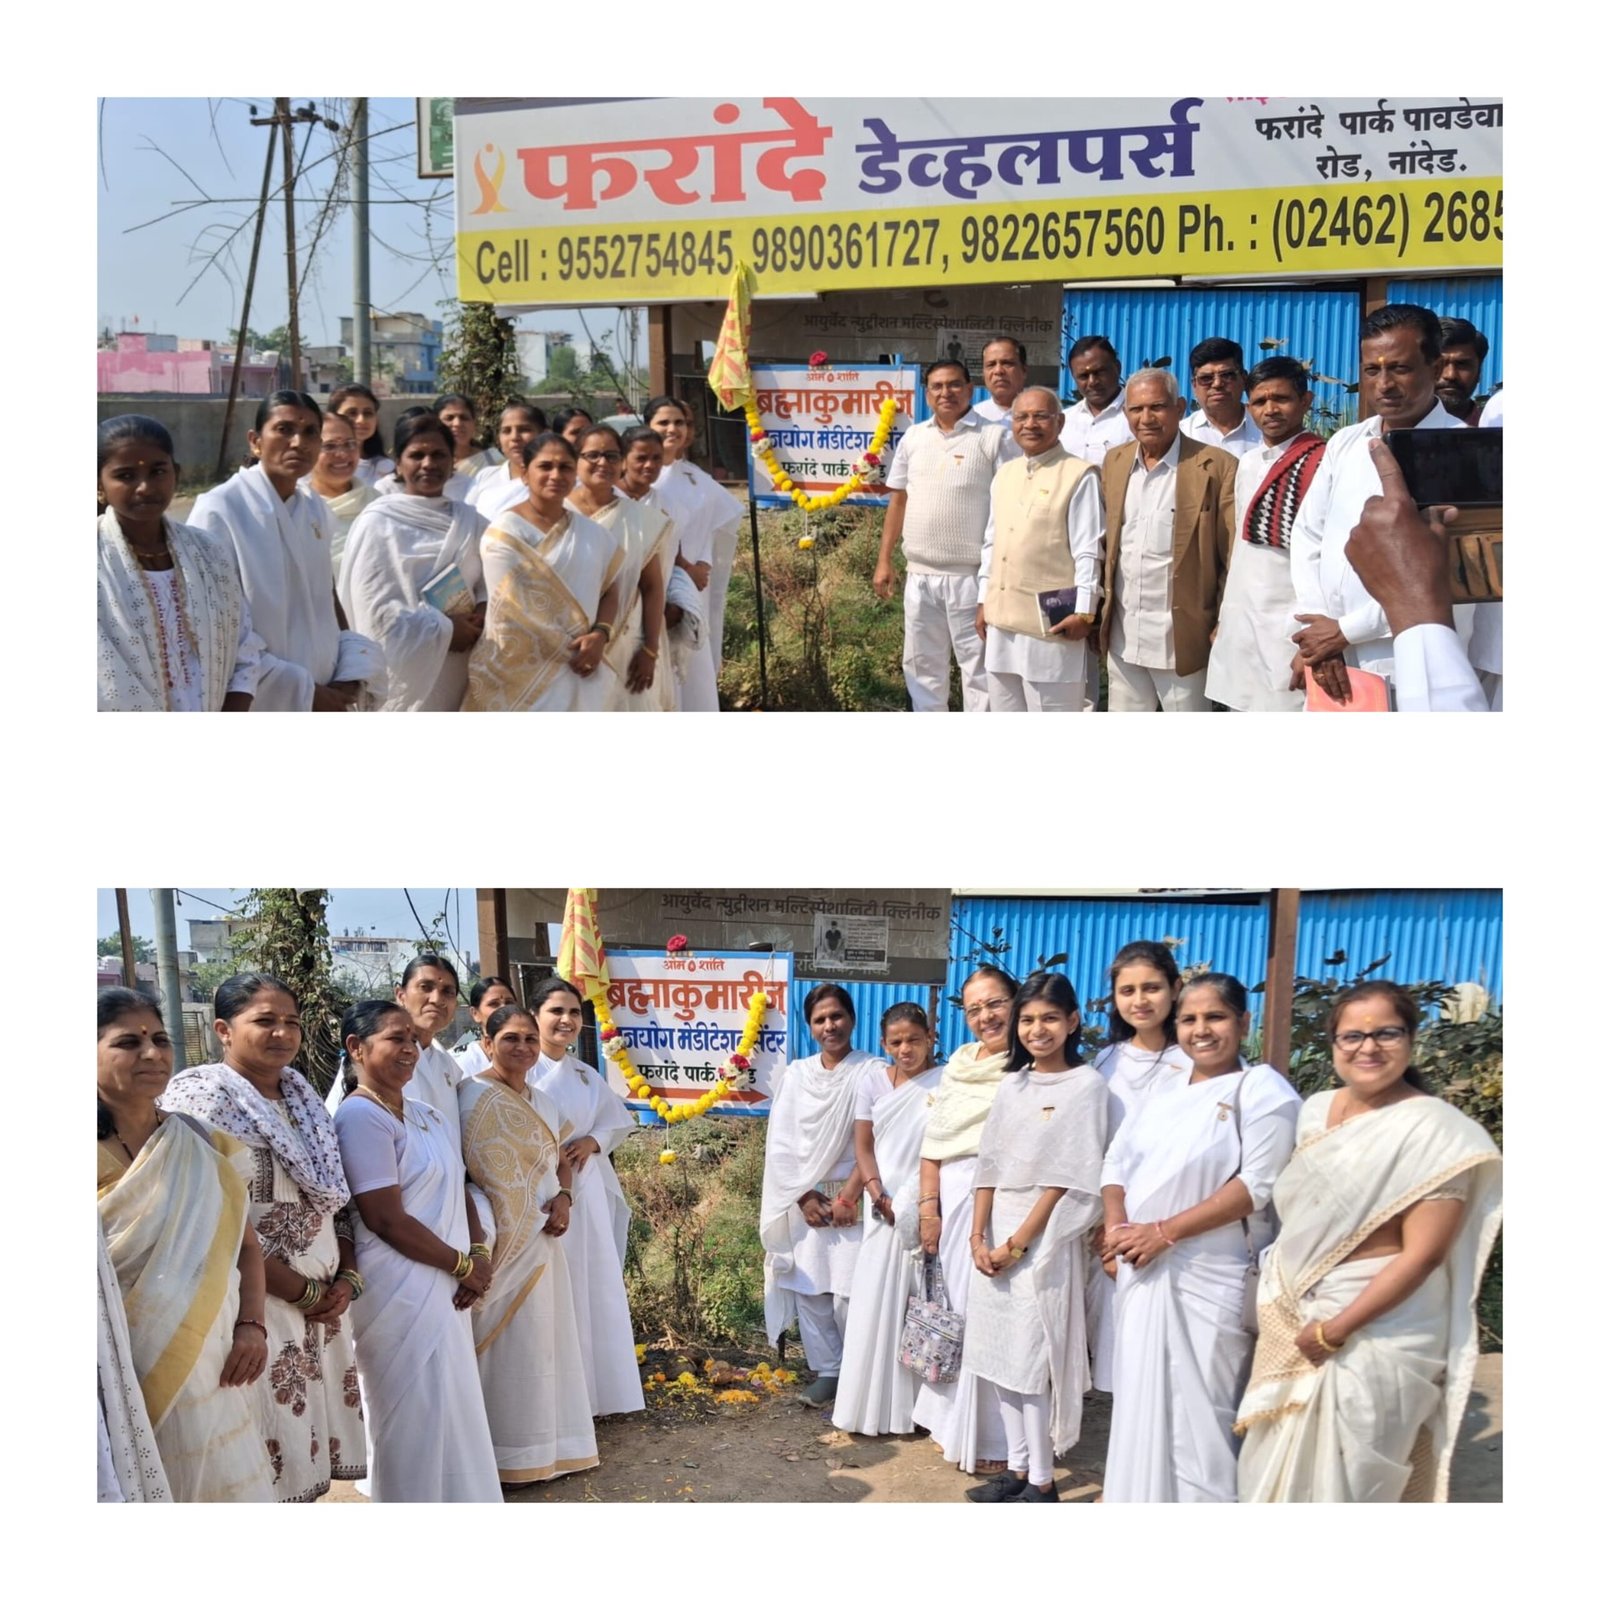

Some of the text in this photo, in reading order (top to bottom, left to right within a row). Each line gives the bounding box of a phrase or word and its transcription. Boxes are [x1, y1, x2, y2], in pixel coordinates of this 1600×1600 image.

[1255, 105, 1325, 141] फरांदे
[1339, 99, 1395, 136] पार्क
[517, 97, 1204, 210] फरांदे डेव्हलपर्स
[1316, 140, 1467, 182] रोड, नांदेड.
[476, 238, 530, 284] Cell
[752, 219, 949, 274] 9890361727,
[961, 206, 1165, 263] 9822657560
[1178, 203, 1234, 253] Ph.
[1272, 193, 1410, 263] (02462)
[781, 458, 819, 478] फरांदे
[637, 1060, 680, 1084] फरांदे
